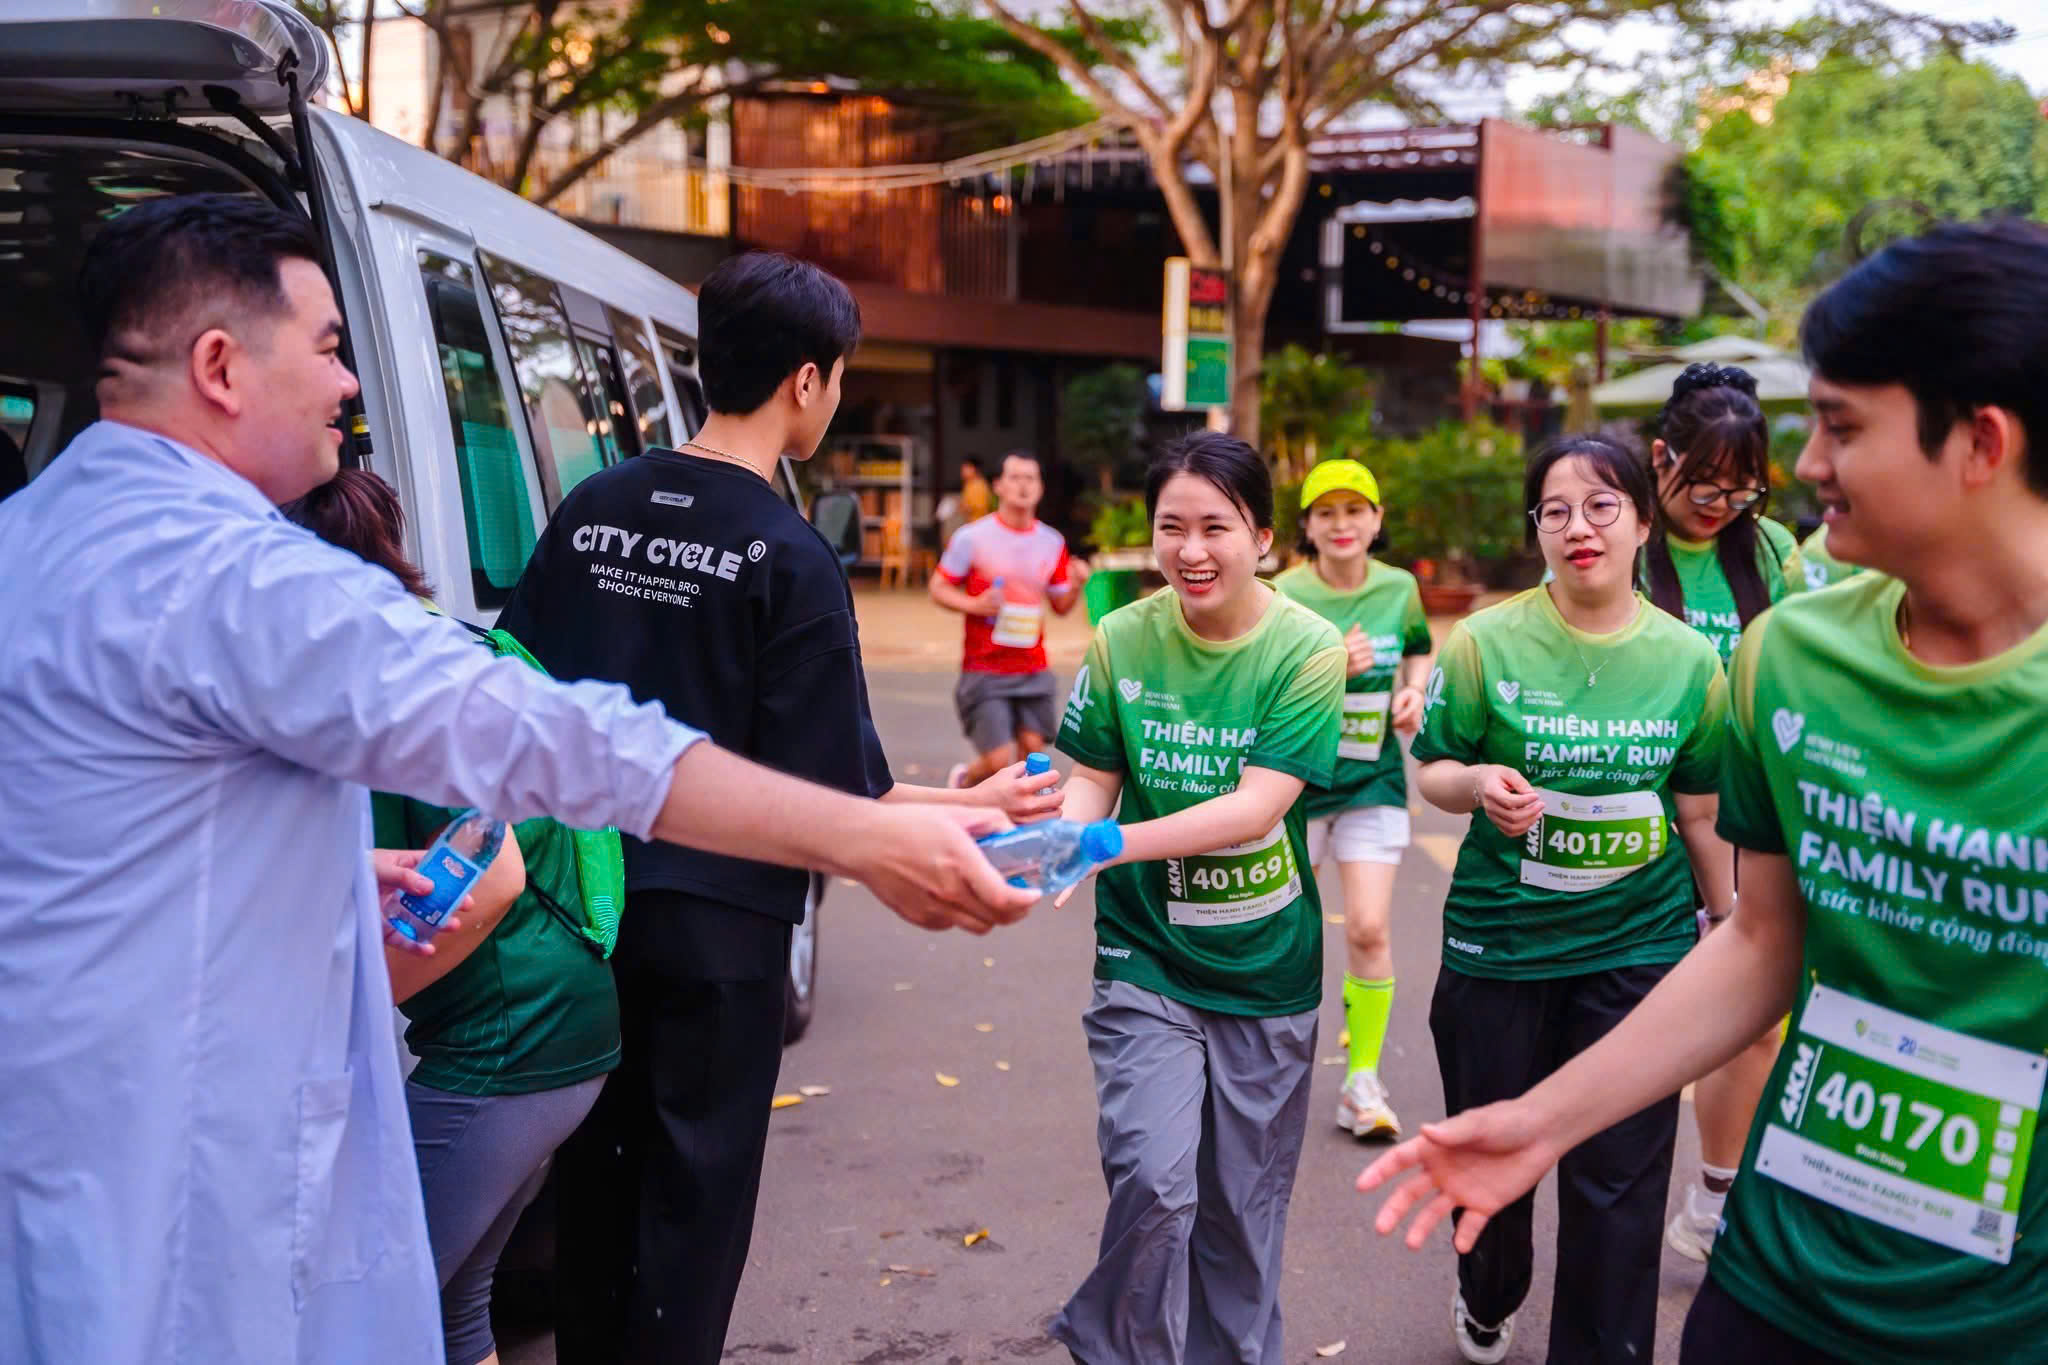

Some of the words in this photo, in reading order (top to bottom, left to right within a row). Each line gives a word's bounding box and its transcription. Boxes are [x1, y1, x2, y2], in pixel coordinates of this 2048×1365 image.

[572, 525, 643, 558] CITY
[646, 538, 744, 582] CYCLE
[590, 563, 623, 580] MAKE
[624, 571, 637, 582] IT
[638, 574, 677, 591] HAPPEN,
[678, 581, 702, 596] BRO.
[597, 578, 641, 598] SHOCK
[643, 589, 694, 608] EVERYONE.
[1141, 720, 1214, 750] THIỆN
[1220, 727, 1257, 754] HẠ
[1521, 714, 1599, 741] THIỆN
[1607, 719, 1678, 742] HẠNH
[1140, 748, 1231, 777] FAMILY
[1525, 742, 1621, 765] FAMILY
[1627, 747, 1676, 767] RUN
[1153, 776, 1178, 791] sức
[1181, 776, 1215, 794] khỏe
[1541, 766, 1565, 778] sức
[1568, 767, 1603, 780] khỏe
[1606, 769, 1640, 786] cộng
[1798, 779, 1917, 847] THIỆN
[1548, 829, 1643, 856] 40179
[1167, 857, 1183, 898] 4KM
[1191, 855, 1282, 890] 40169
[1799, 831, 1948, 904] FAMILY
[1819, 887, 1863, 916] sức
[1867, 897, 1924, 931] khỏe
[1929, 917, 1993, 954] cộng
[1779, 1042, 1815, 1124] 4KM
[1815, 1071, 1980, 1166] 40170
